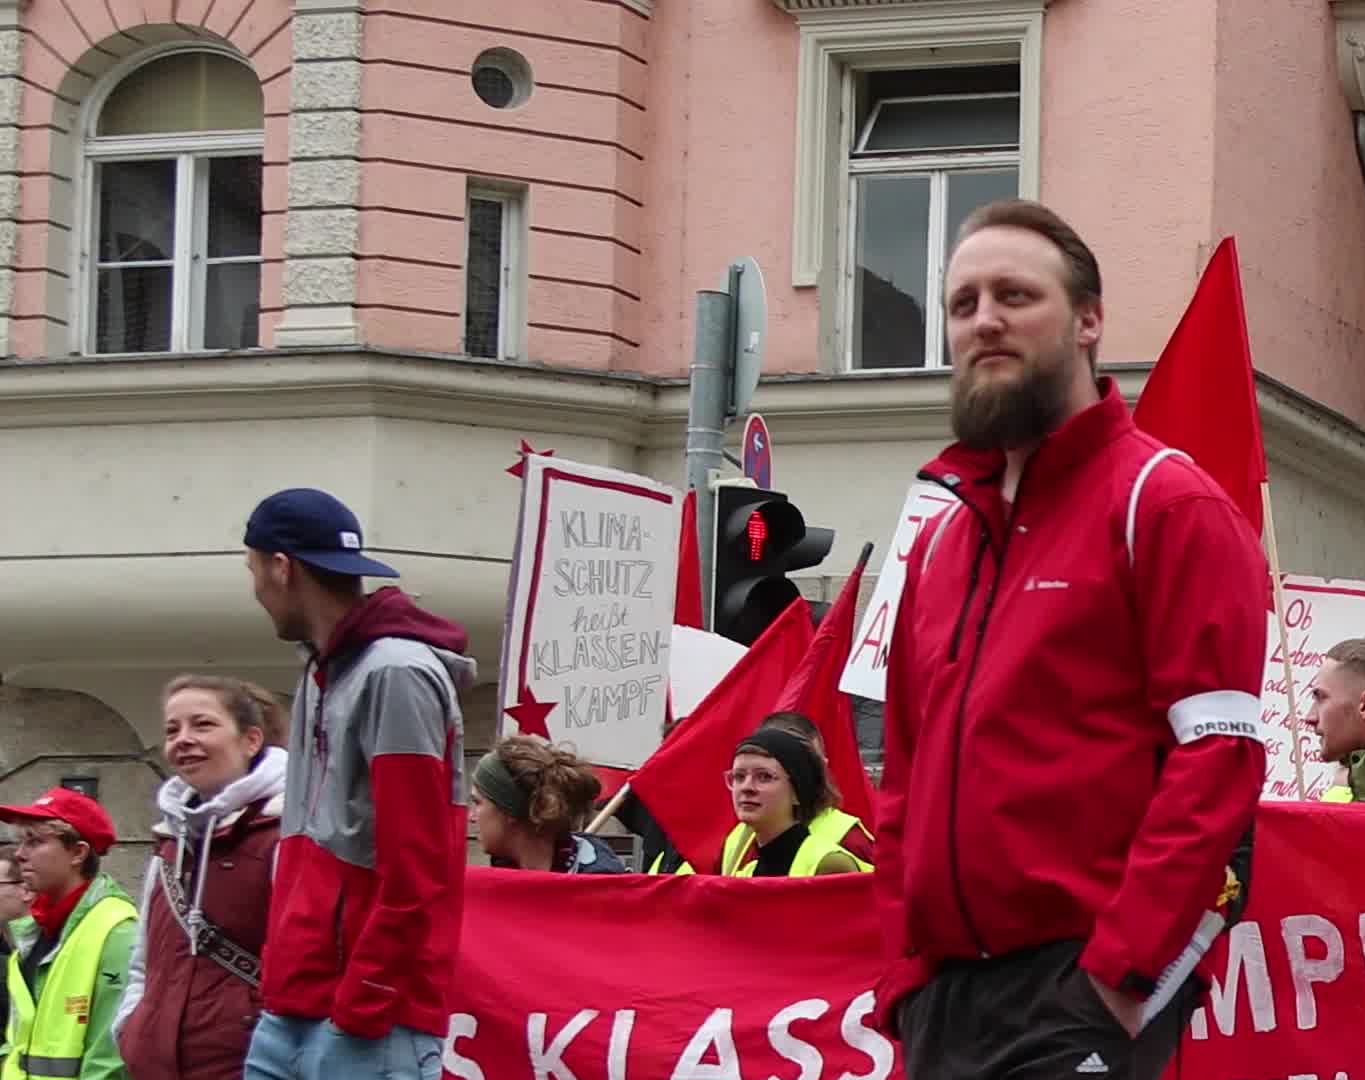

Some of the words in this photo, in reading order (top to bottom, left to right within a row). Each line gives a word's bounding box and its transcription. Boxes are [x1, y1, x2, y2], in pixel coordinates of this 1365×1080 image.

[560, 510, 650, 551] KLIMA-
[553, 559, 655, 599] SCHUTZ
[571, 602, 629, 634] heißt
[1285, 598, 1313, 630] Ob
[532, 631, 669, 681] KLASSEN-
[564, 675, 661, 729] KAMPF
